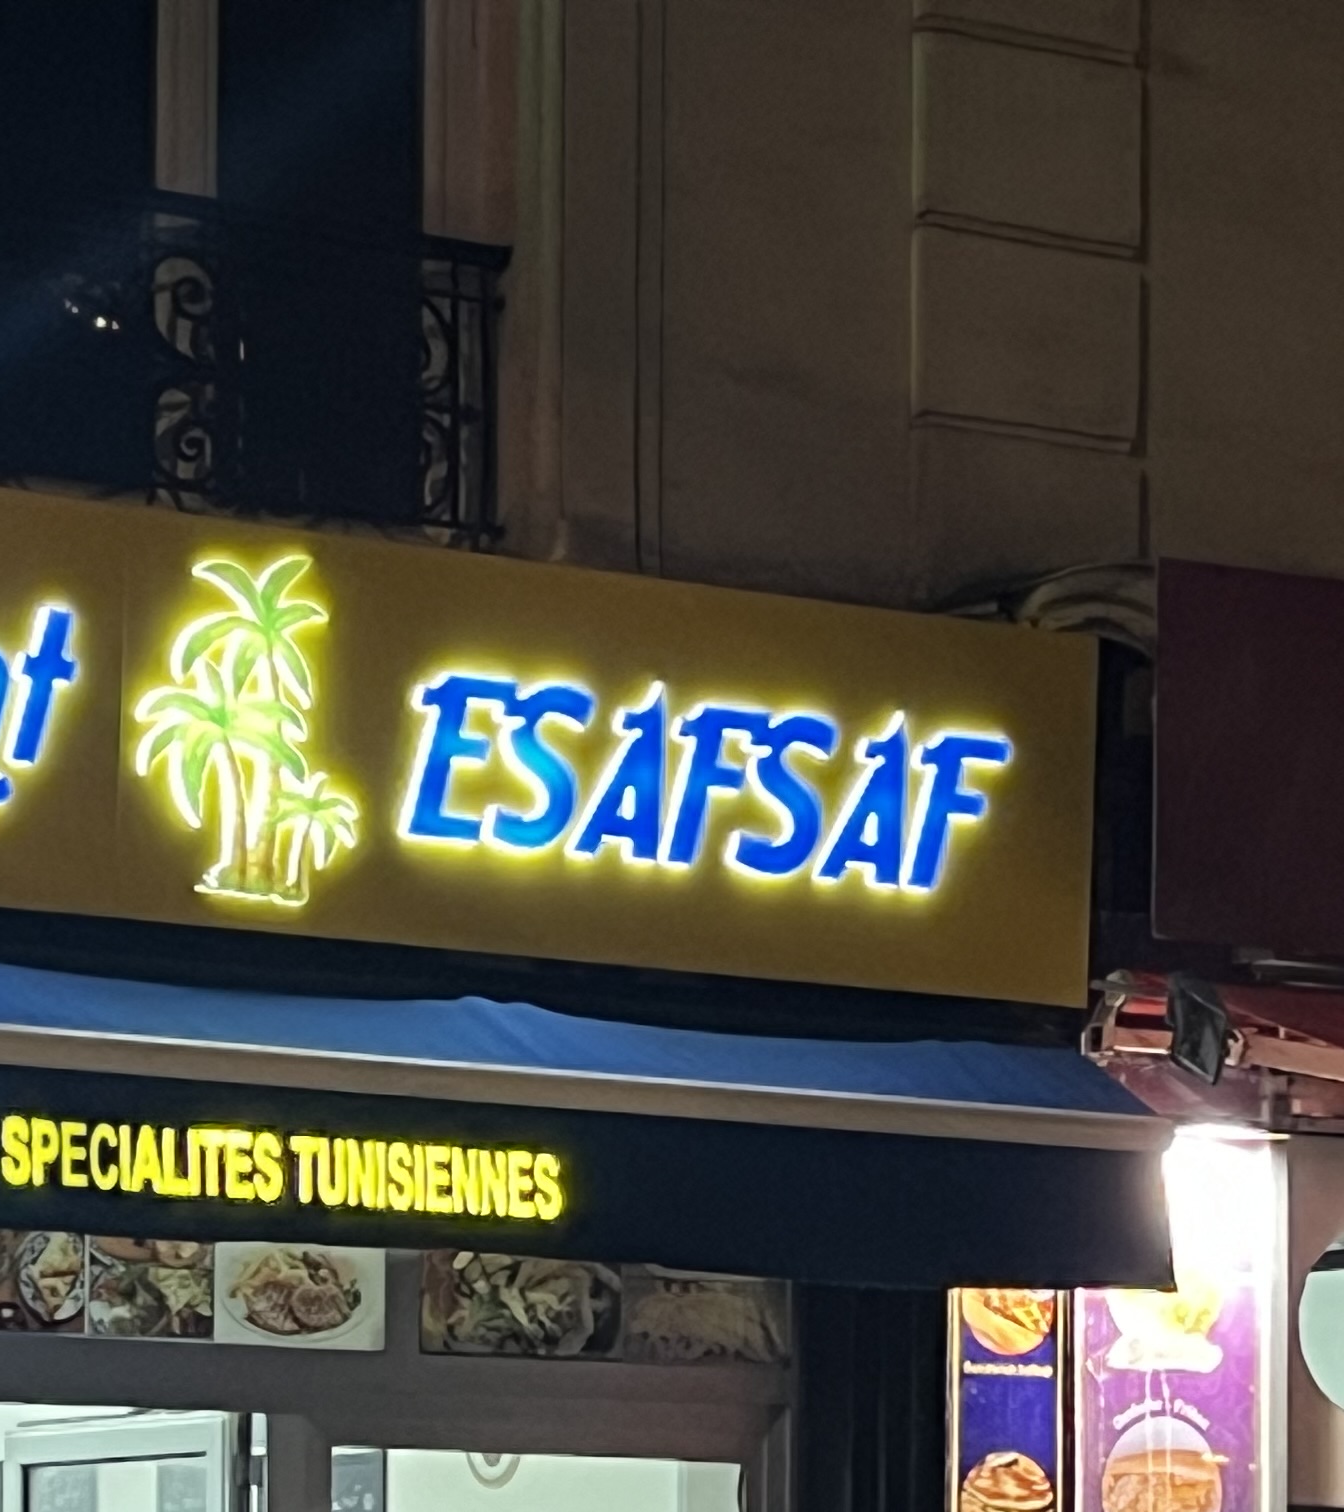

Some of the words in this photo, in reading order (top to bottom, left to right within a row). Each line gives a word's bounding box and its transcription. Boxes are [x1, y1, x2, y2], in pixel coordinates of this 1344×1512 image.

[397, 670, 1014, 893] ESAFSAF
[0, 1113, 284, 1201] SPECIALITES
[288, 1133, 564, 1221] TUNISIENNES
